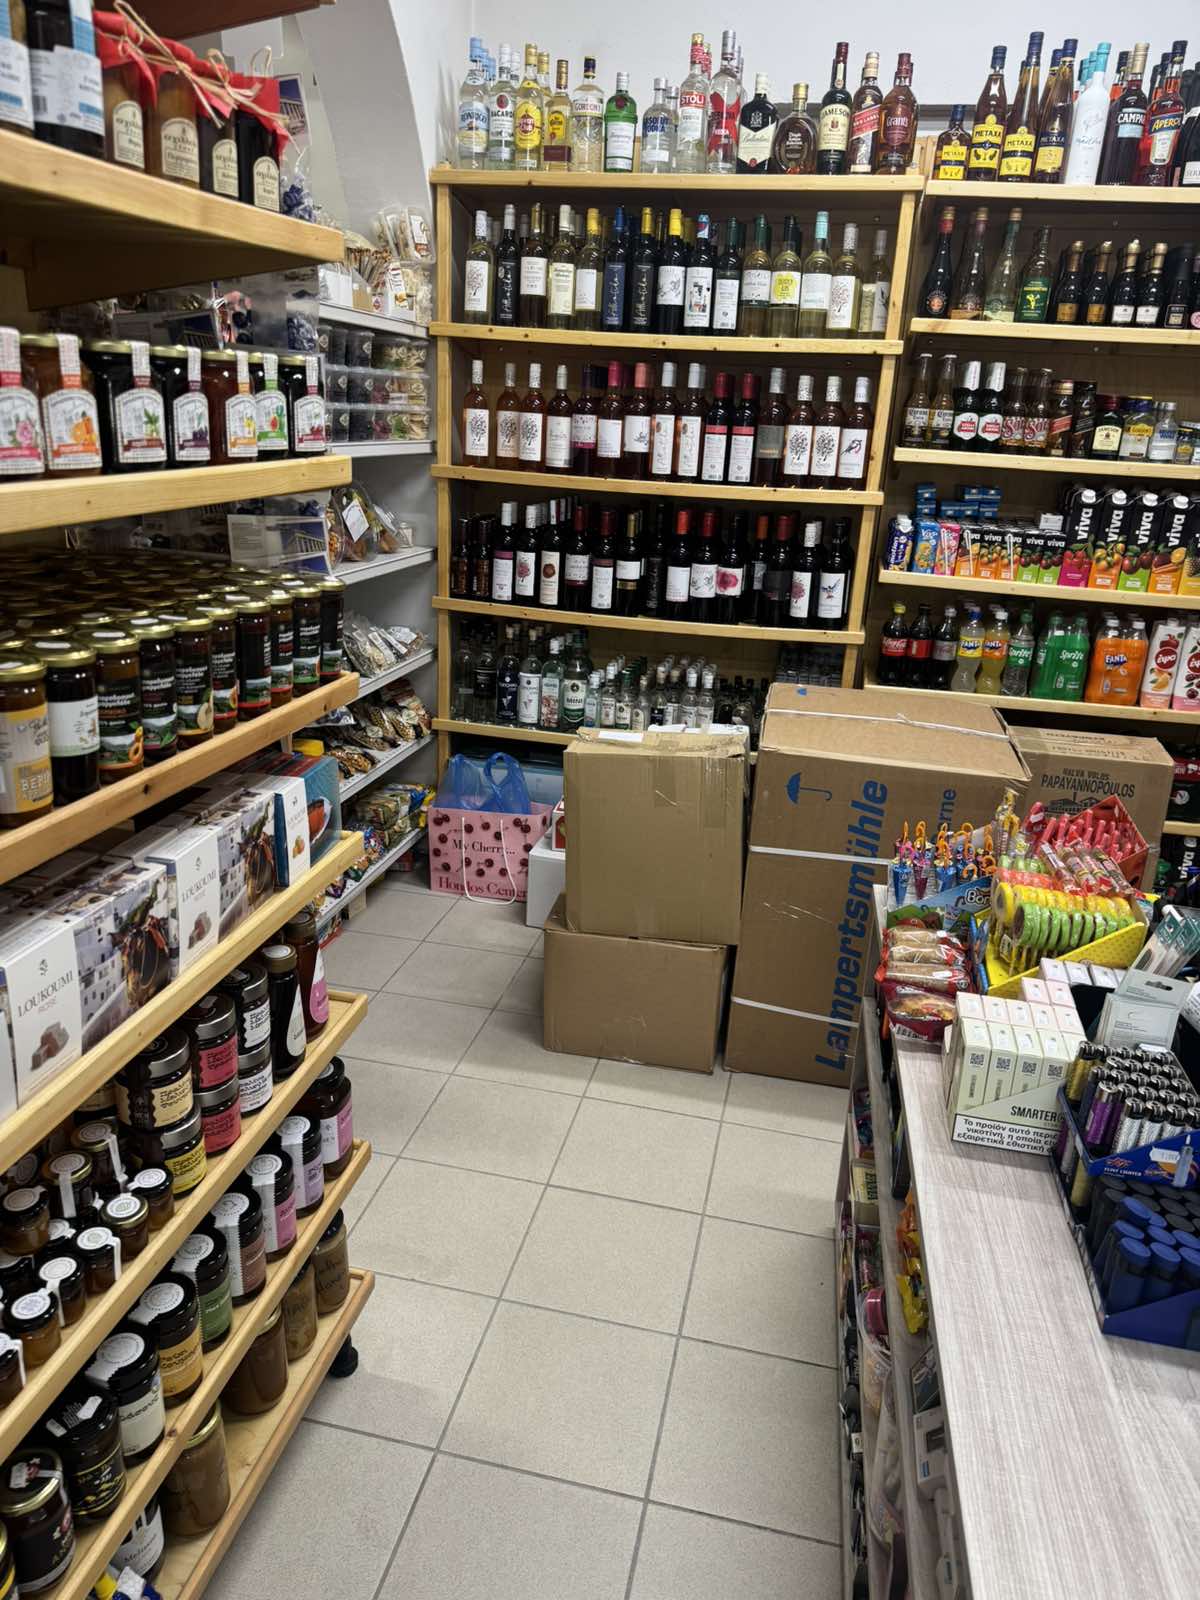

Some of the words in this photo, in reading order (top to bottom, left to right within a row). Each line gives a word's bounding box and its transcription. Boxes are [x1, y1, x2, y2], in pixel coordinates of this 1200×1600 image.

[681, 95, 704, 105] STOLI
[974, 129, 1002, 137] METAXA
[1040, 135, 1065, 143] METAXA
[1074, 507, 1094, 540] viva
[1105, 509, 1124, 542] viva
[1135, 511, 1154, 545] viva
[1166, 514, 1186, 547] viva
[984, 533, 1002, 542] viva
[1026, 537, 1044, 545] viva
[1047, 539, 1066, 547] viva
[1060, 649, 1084, 660] Sprite
[1105, 654, 1128, 664] FANTA
[1062, 767, 1085, 778] HALVA
[1040, 774, 1136, 798] PAPAYANNOPOULOS
[452, 839, 469, 851] My
[1177, 851, 1195, 880] viva
[815, 779, 889, 1071] Lampertsmühle
[17, 969, 74, 1017] LOUKOUMI
[1010, 1105, 1064, 1123] SMARTER
[963, 1118, 974, 1127] Το
[975, 1120, 1007, 1132] προϊόν
[1008, 1125, 1031, 1136] αυτό
[957, 1132, 1005, 1146] εξαιρετικά
[1006, 1140, 1044, 1153] εθιστική
[1015, 1135, 1042, 1145] οποία
